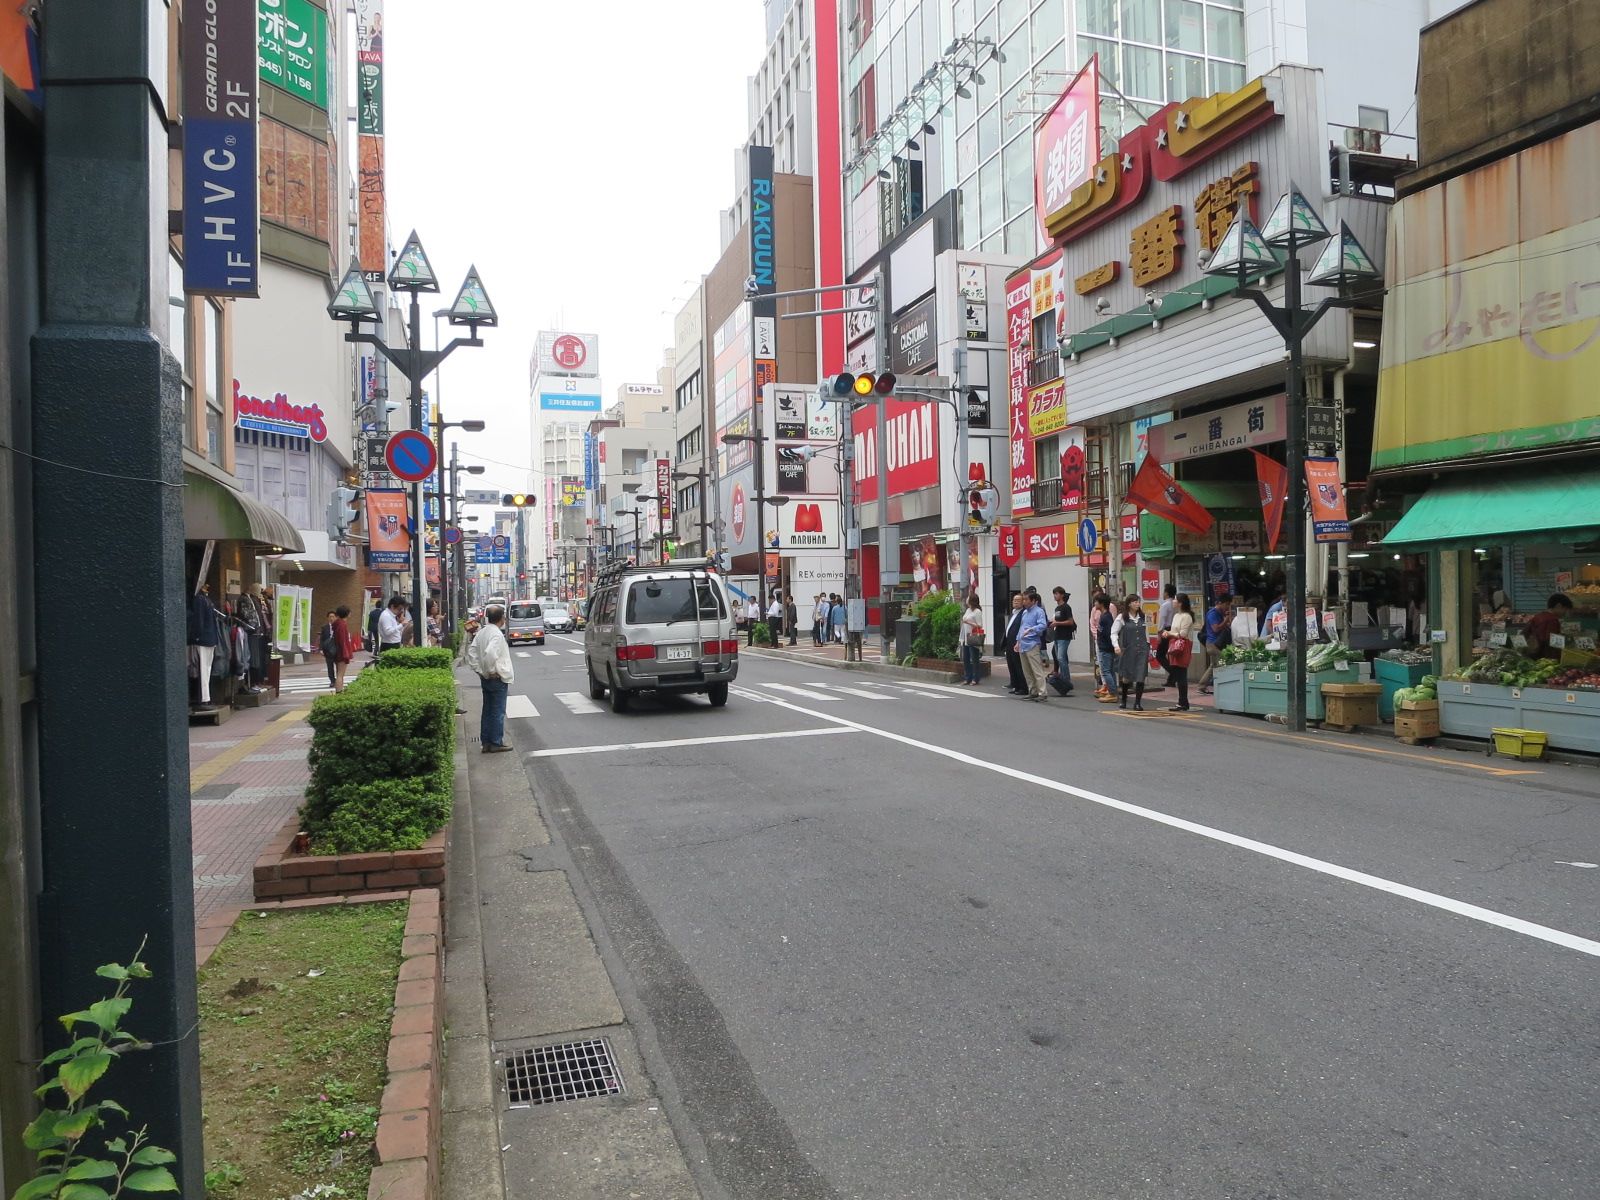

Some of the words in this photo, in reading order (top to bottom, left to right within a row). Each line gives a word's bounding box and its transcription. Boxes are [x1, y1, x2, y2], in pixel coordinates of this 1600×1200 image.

[288, 51, 312, 70] サロン
[359, 53, 381, 61] LAVA
[205, 46, 217, 112] GRAND
[287, 71, 312, 91] 1156
[227, 81, 250, 119] 2F
[1046, 113, 1088, 208] 楽園
[752, 178, 774, 286] RAKUUN
[227, 252, 251, 286] 1F
[900, 320, 929, 351] CUSTOMA
[907, 345, 922, 367] CAFE
[1174, 406, 1265, 442] 一番街
[854, 402, 933, 482] MAUHAN
[1188, 435, 1247, 455] ICHIBANGAI
[779, 464, 804, 472] CUSTOMA
[790, 535, 827, 545] MARUHAN
[1030, 533, 1059, 554] 宝くじ
[798, 570, 815, 579] REX
[816, 570, 845, 580] oomiya
